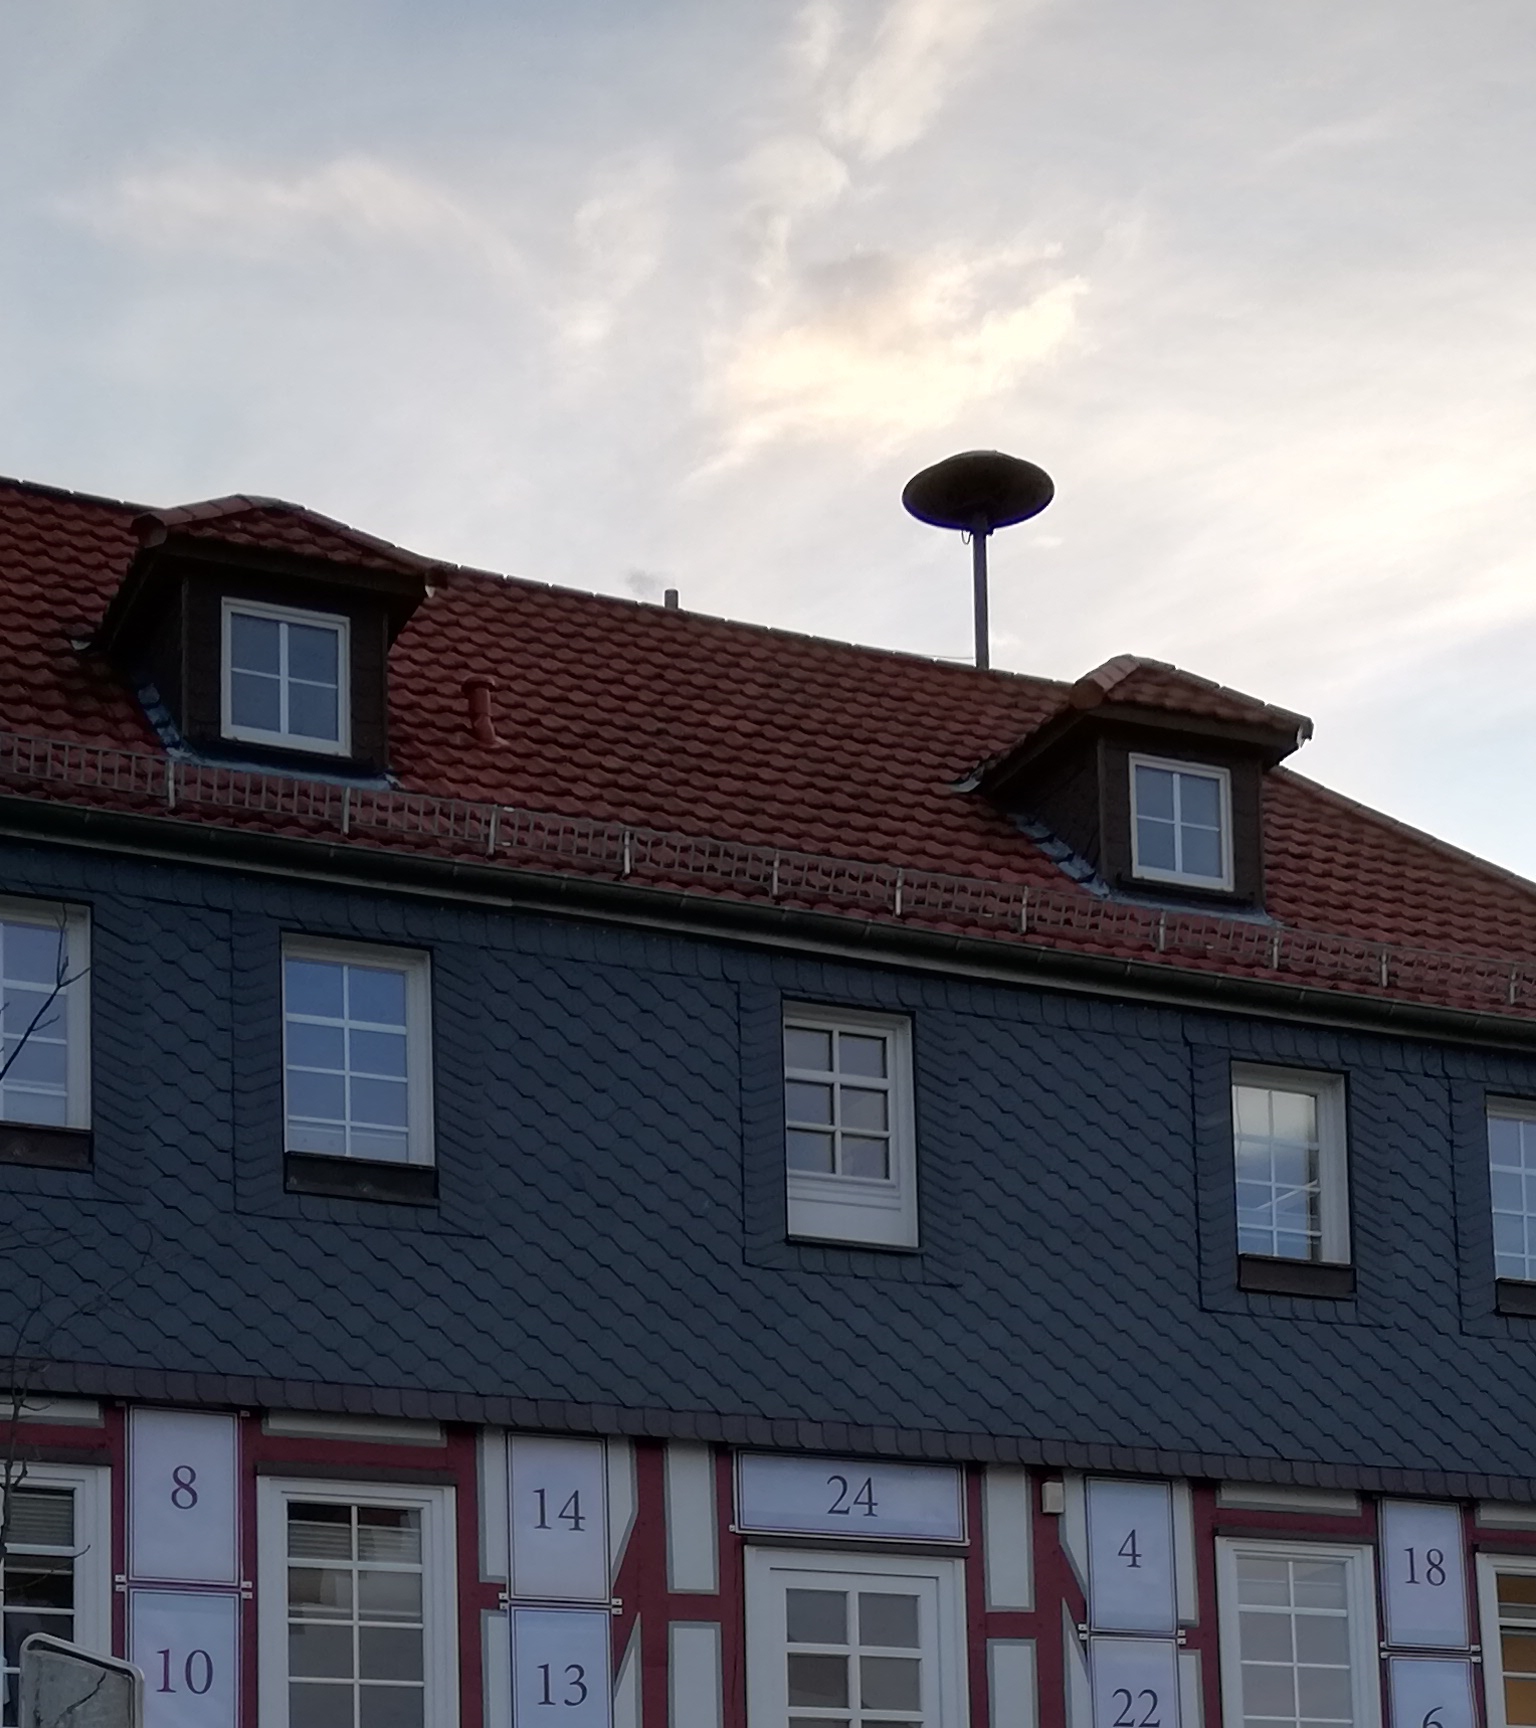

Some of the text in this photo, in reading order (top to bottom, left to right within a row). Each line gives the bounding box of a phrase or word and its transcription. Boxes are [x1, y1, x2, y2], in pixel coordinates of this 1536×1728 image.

[170, 1465, 198, 1510] 8
[827, 1475, 879, 1517] 24
[532, 1488, 586, 1532] 14
[1117, 1529, 1142, 1568] 4
[1404, 1546, 1446, 1587] 18
[156, 1648, 214, 1695] 10
[537, 1663, 588, 1707] 13
[1112, 1688, 1162, 1728] 22
